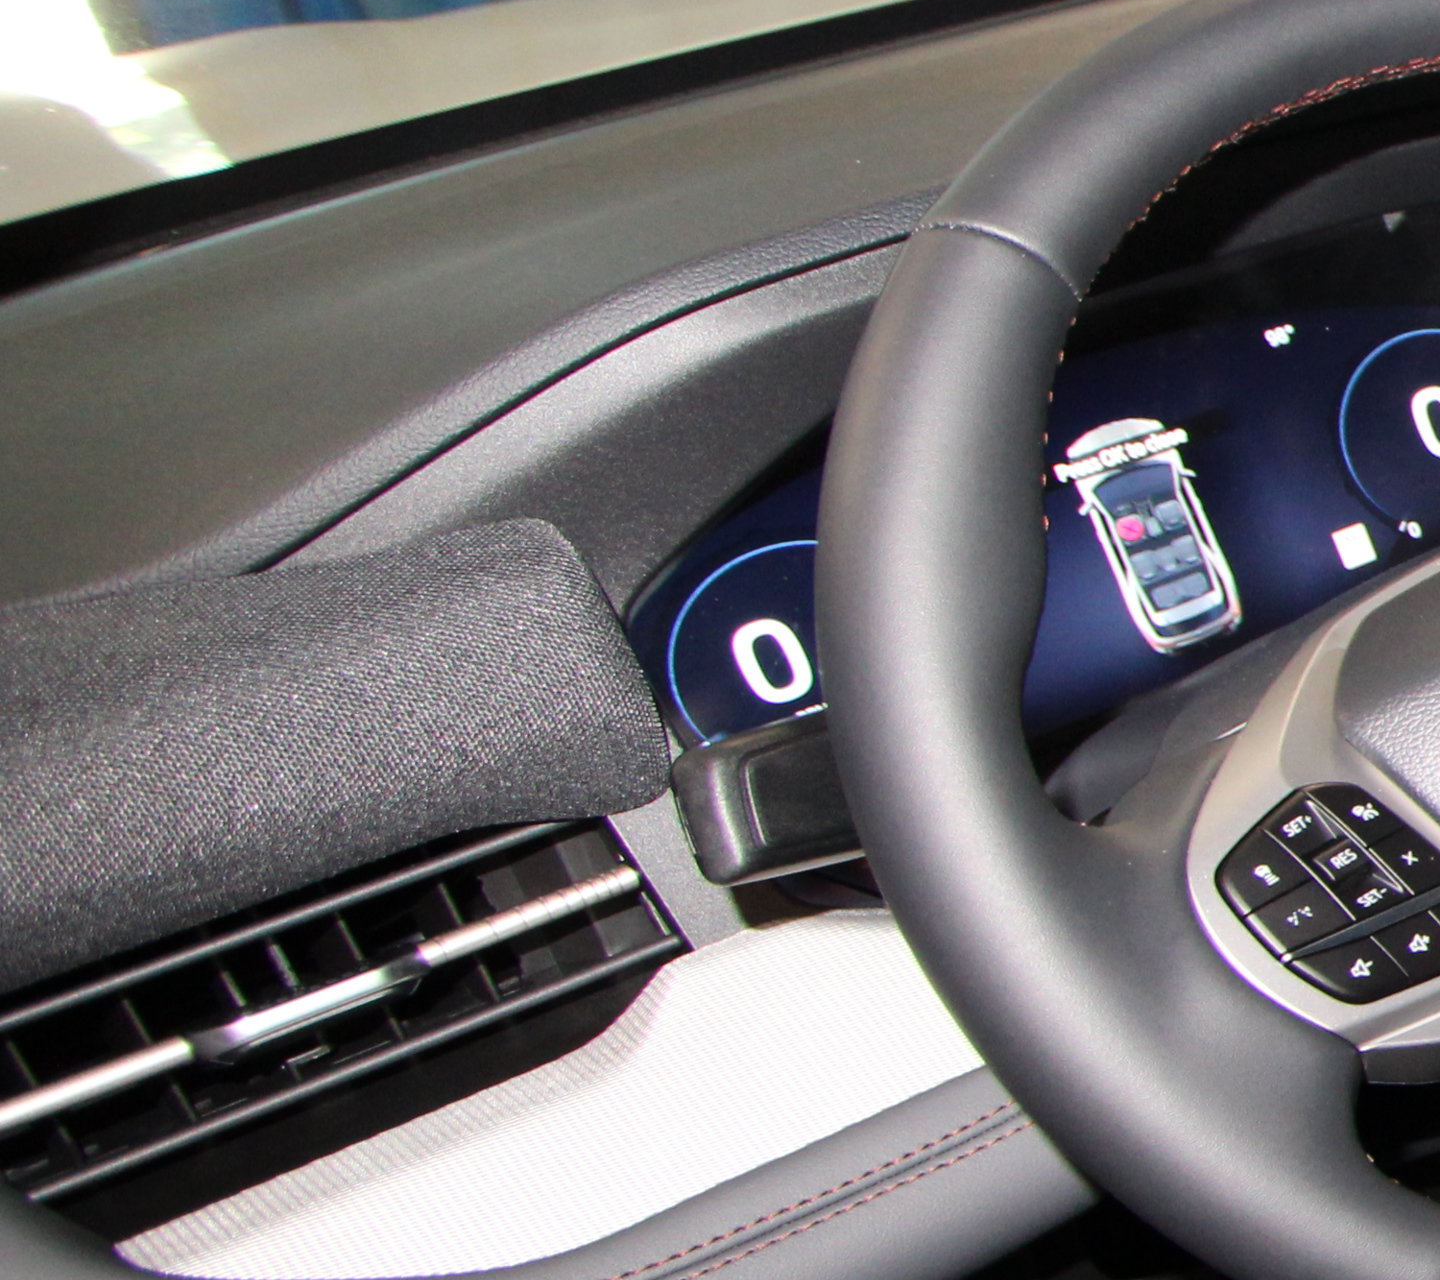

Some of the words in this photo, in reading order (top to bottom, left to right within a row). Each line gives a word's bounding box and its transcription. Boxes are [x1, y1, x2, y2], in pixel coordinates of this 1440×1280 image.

[1052, 456, 1104, 484] Press
[1098, 444, 1130, 468] OK
[1124, 441, 1148, 460] to
[1144, 428, 1190, 451] close
[730, 618, 814, 704] 0
[1282, 815, 1312, 839] SET+
[1329, 847, 1358, 870] RES
[1356, 887, 1388, 908] SET-
